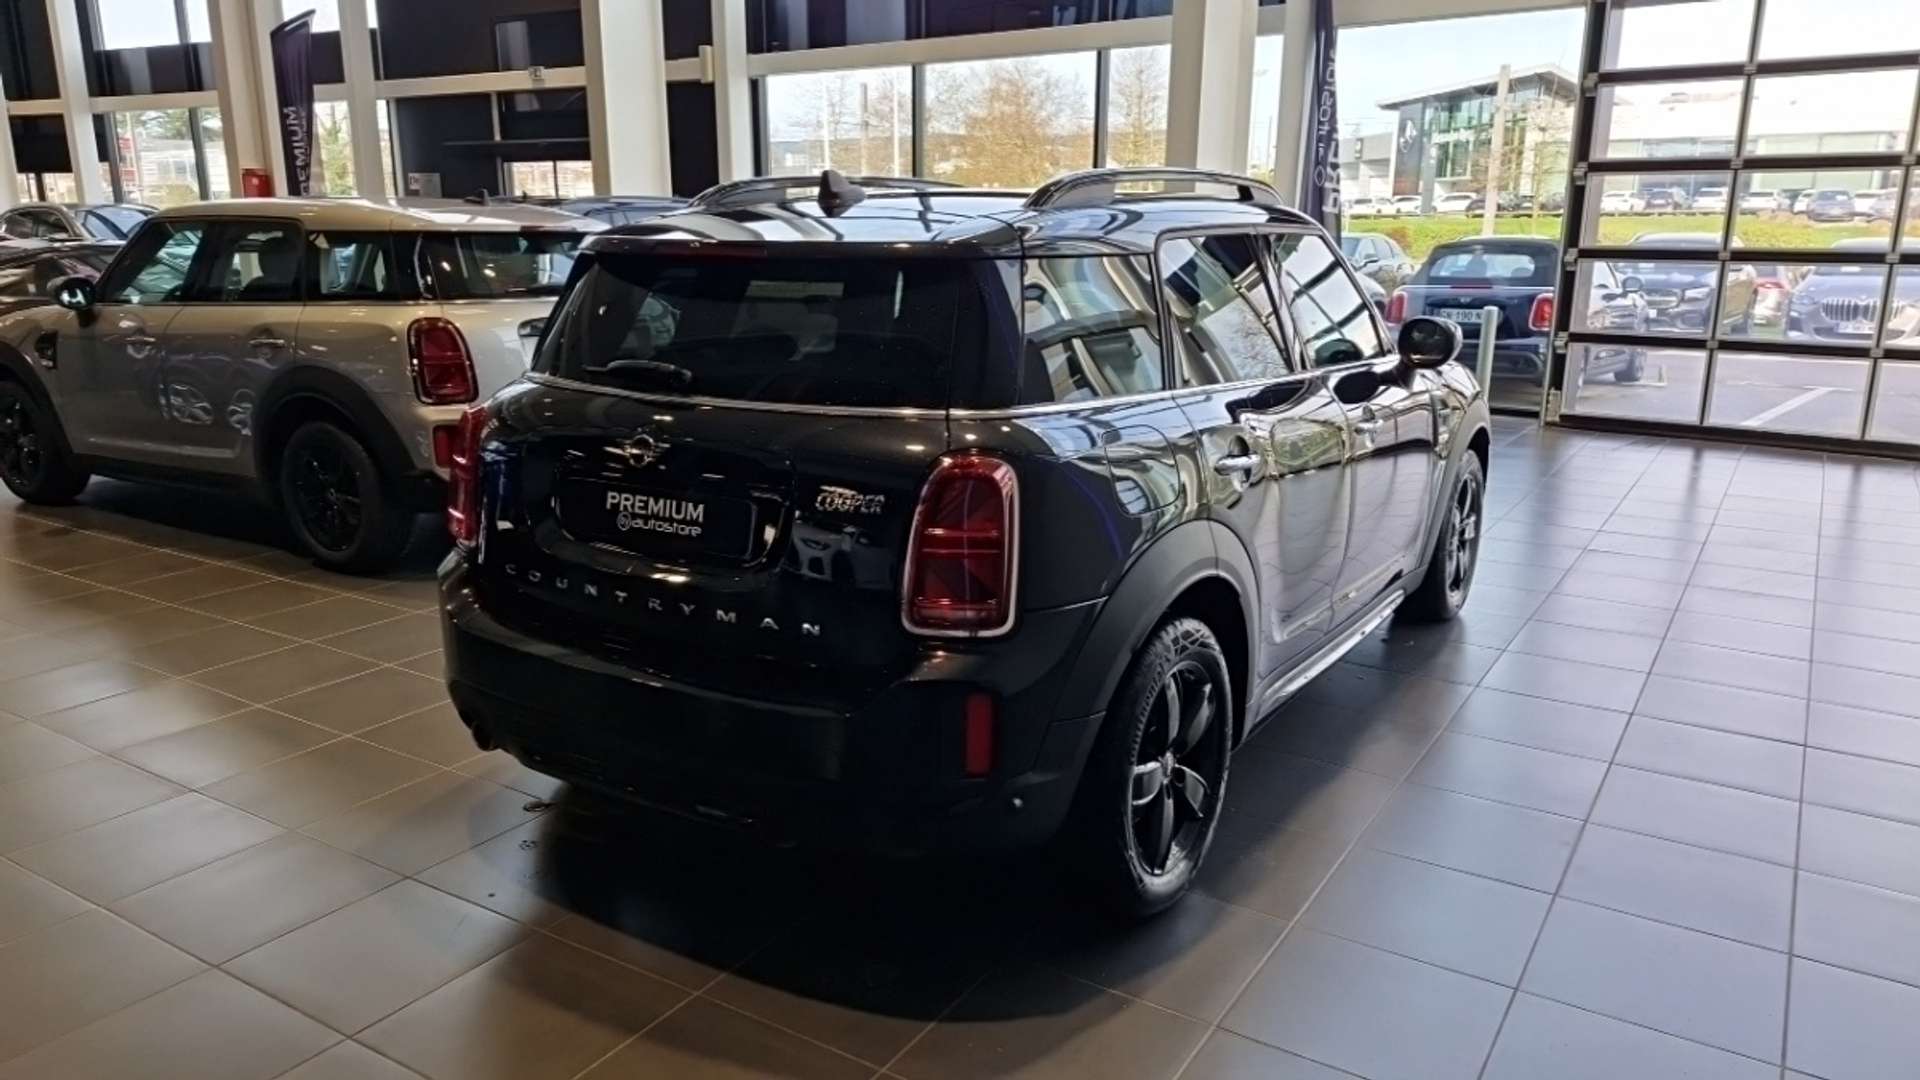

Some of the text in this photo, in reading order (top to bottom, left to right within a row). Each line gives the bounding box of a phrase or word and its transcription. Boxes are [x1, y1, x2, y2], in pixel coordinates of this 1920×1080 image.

[605, 491, 705, 523] PREMIUM
[815, 490, 886, 515] COOPER
[631, 517, 703, 537] autostore
[505, 563, 821, 637] COUNTRYMAN
